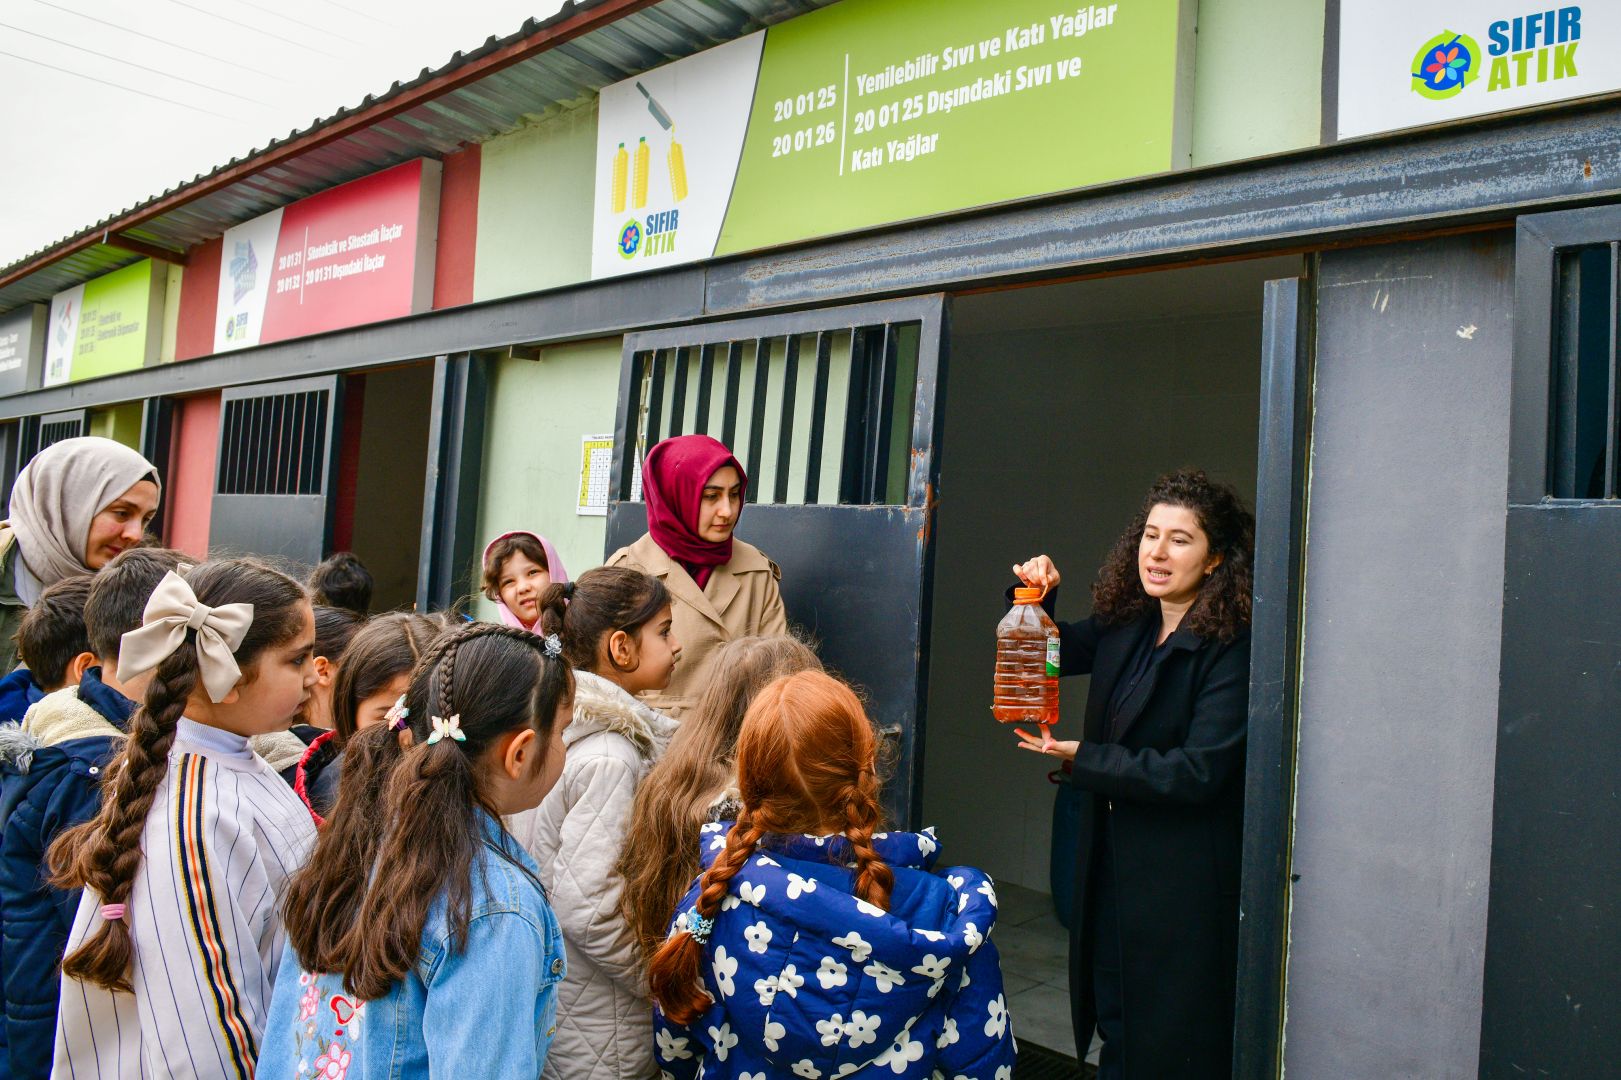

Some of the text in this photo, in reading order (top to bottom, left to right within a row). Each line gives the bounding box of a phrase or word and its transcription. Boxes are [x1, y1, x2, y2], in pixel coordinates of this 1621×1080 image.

[856, 3, 1118, 96] Yenilebilir Sıvı ve Katı Yağlar
[1487, 5, 1582, 56] SIFIR
[1487, 41, 1579, 92] ATIK
[773, 84, 837, 122] 20 01 25
[854, 56, 1082, 135] 20 01 25 Dışındaki Sıvı ve
[772, 121, 836, 158] 20 01 26
[851, 132, 939, 173] Katı Yağlar
[645, 209, 679, 236] SIFIR
[339, 240, 347, 253] ve
[643, 231, 677, 257] ATIK
[306, 270, 314, 285] 20
[315, 267, 323, 283] 01
[324, 265, 332, 280] 31
